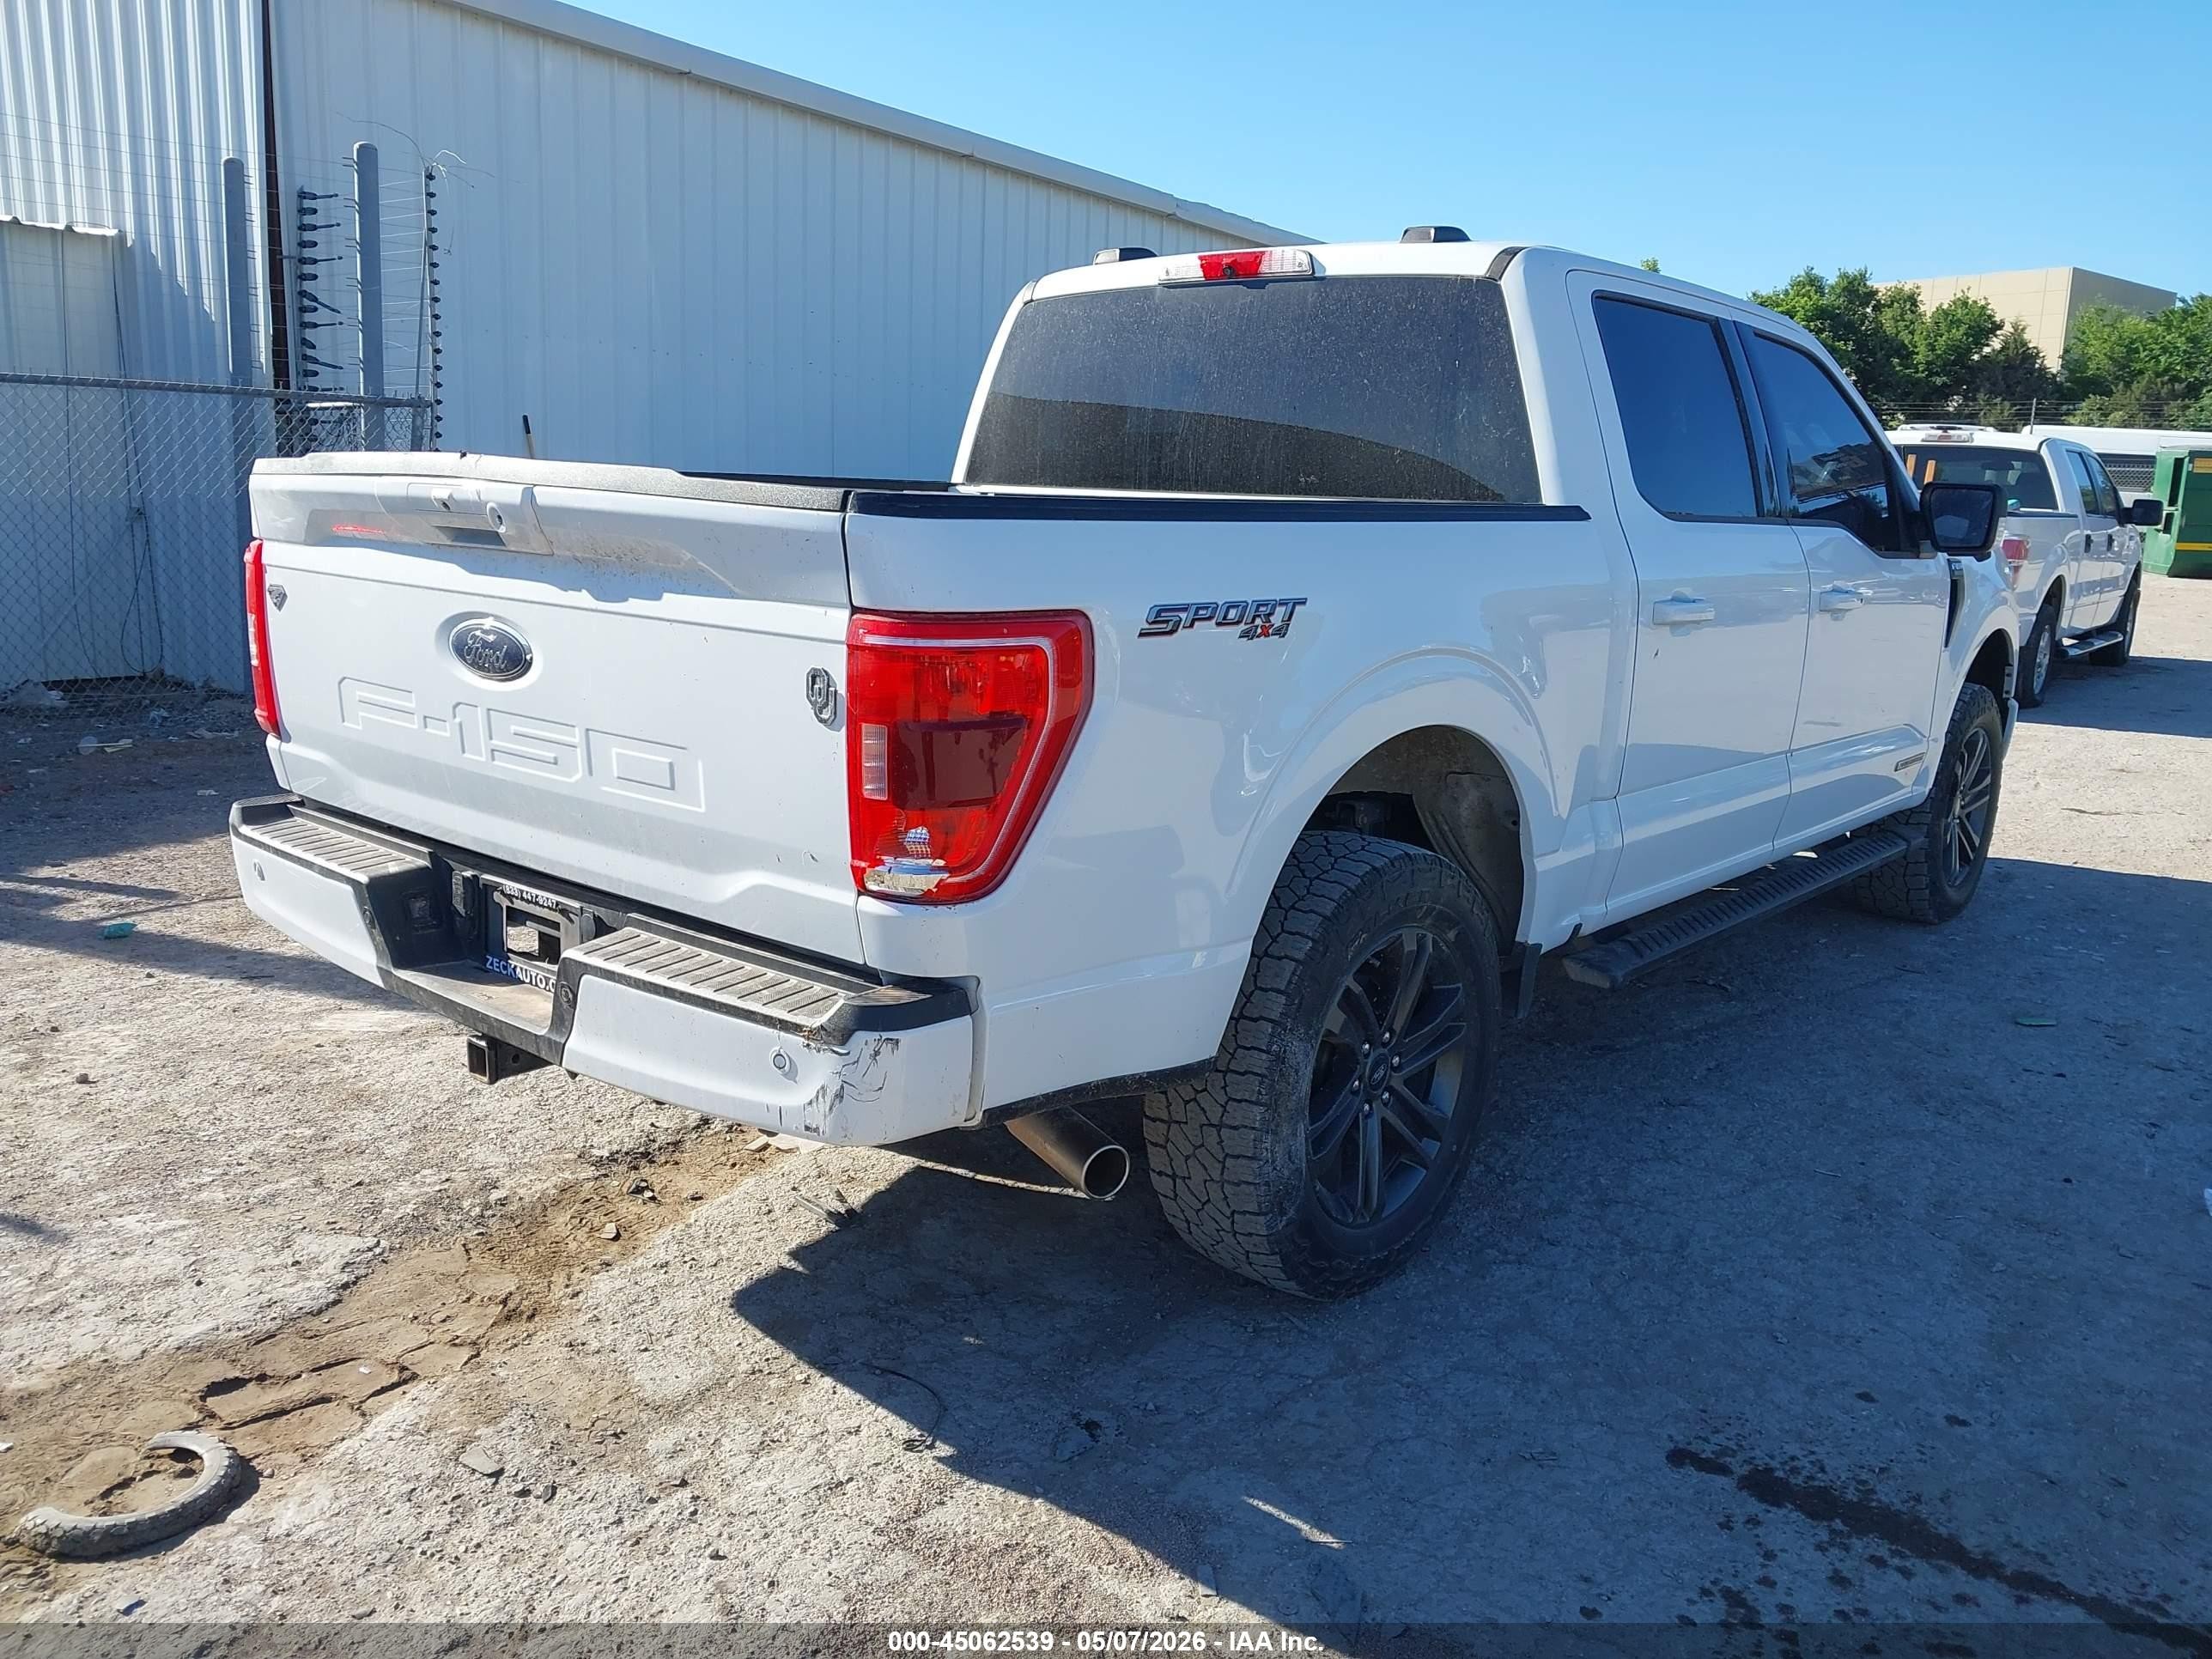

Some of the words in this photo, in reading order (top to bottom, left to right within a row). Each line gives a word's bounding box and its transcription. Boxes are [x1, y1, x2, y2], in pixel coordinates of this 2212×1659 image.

[1138, 598, 1308, 638] SPORT
[464, 629, 508, 669] Ford
[338, 677, 705, 812] F-150
